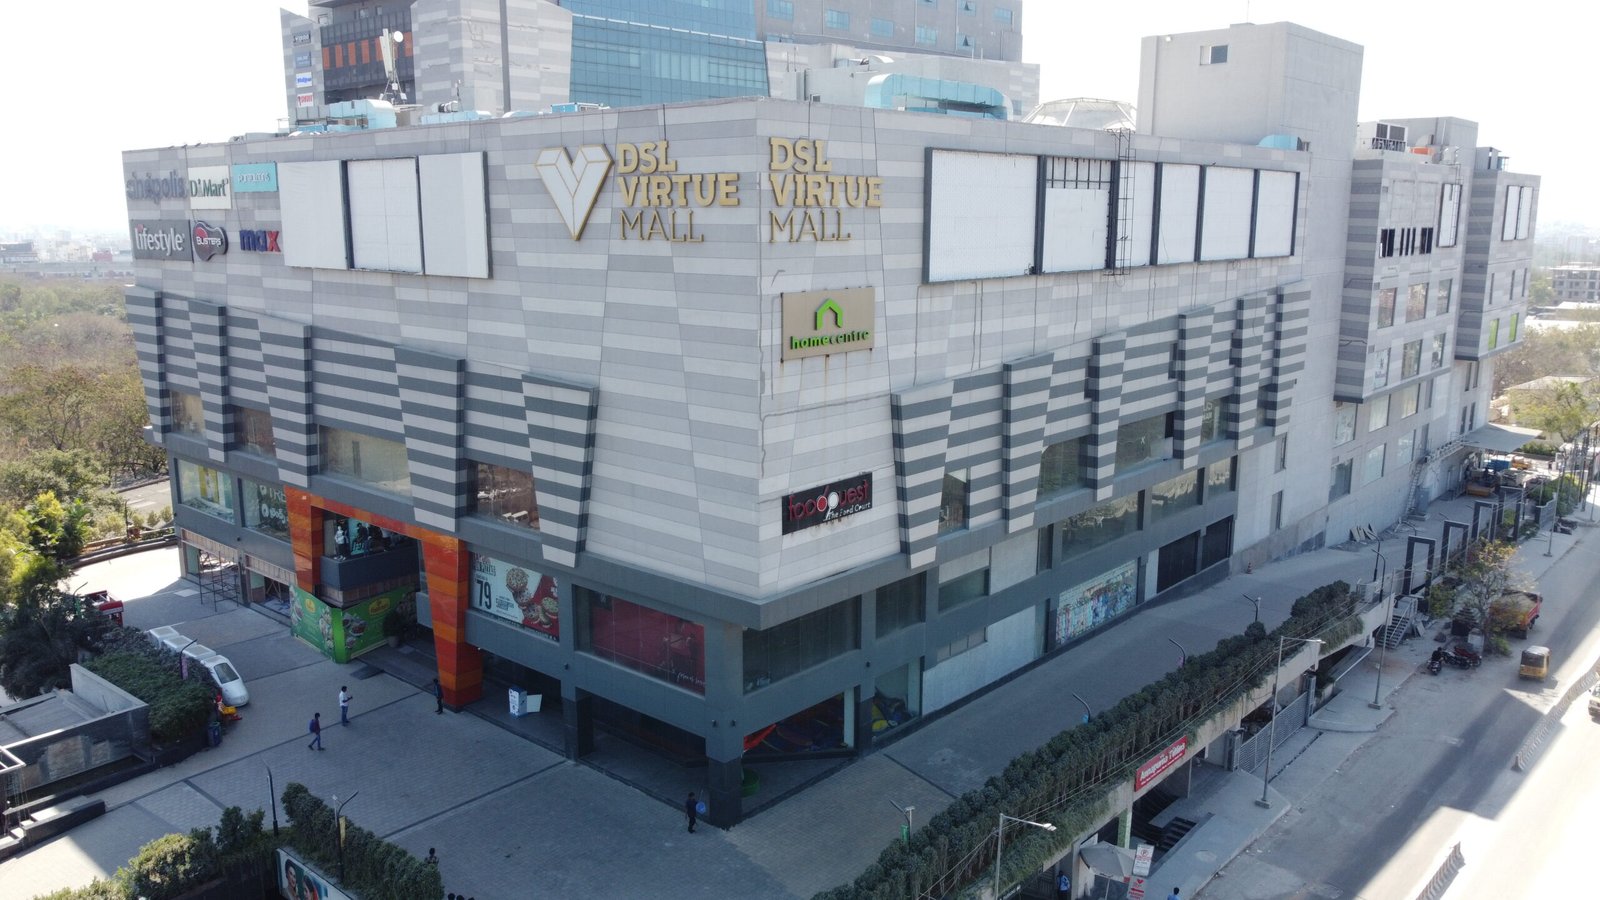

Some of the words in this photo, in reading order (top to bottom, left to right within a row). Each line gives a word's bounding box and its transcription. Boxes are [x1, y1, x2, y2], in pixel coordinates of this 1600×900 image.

[616, 139, 678, 175] DSL
[769, 137, 832, 174] DSL
[617, 172, 739, 208] VIRTUE
[769, 172, 883, 208] VIRTUE
[135, 224, 185, 256] lifestyle
[239, 229, 281, 252] max
[620, 208, 704, 242] MALL
[769, 207, 852, 243] MALL
[476, 579, 491, 610] 79
